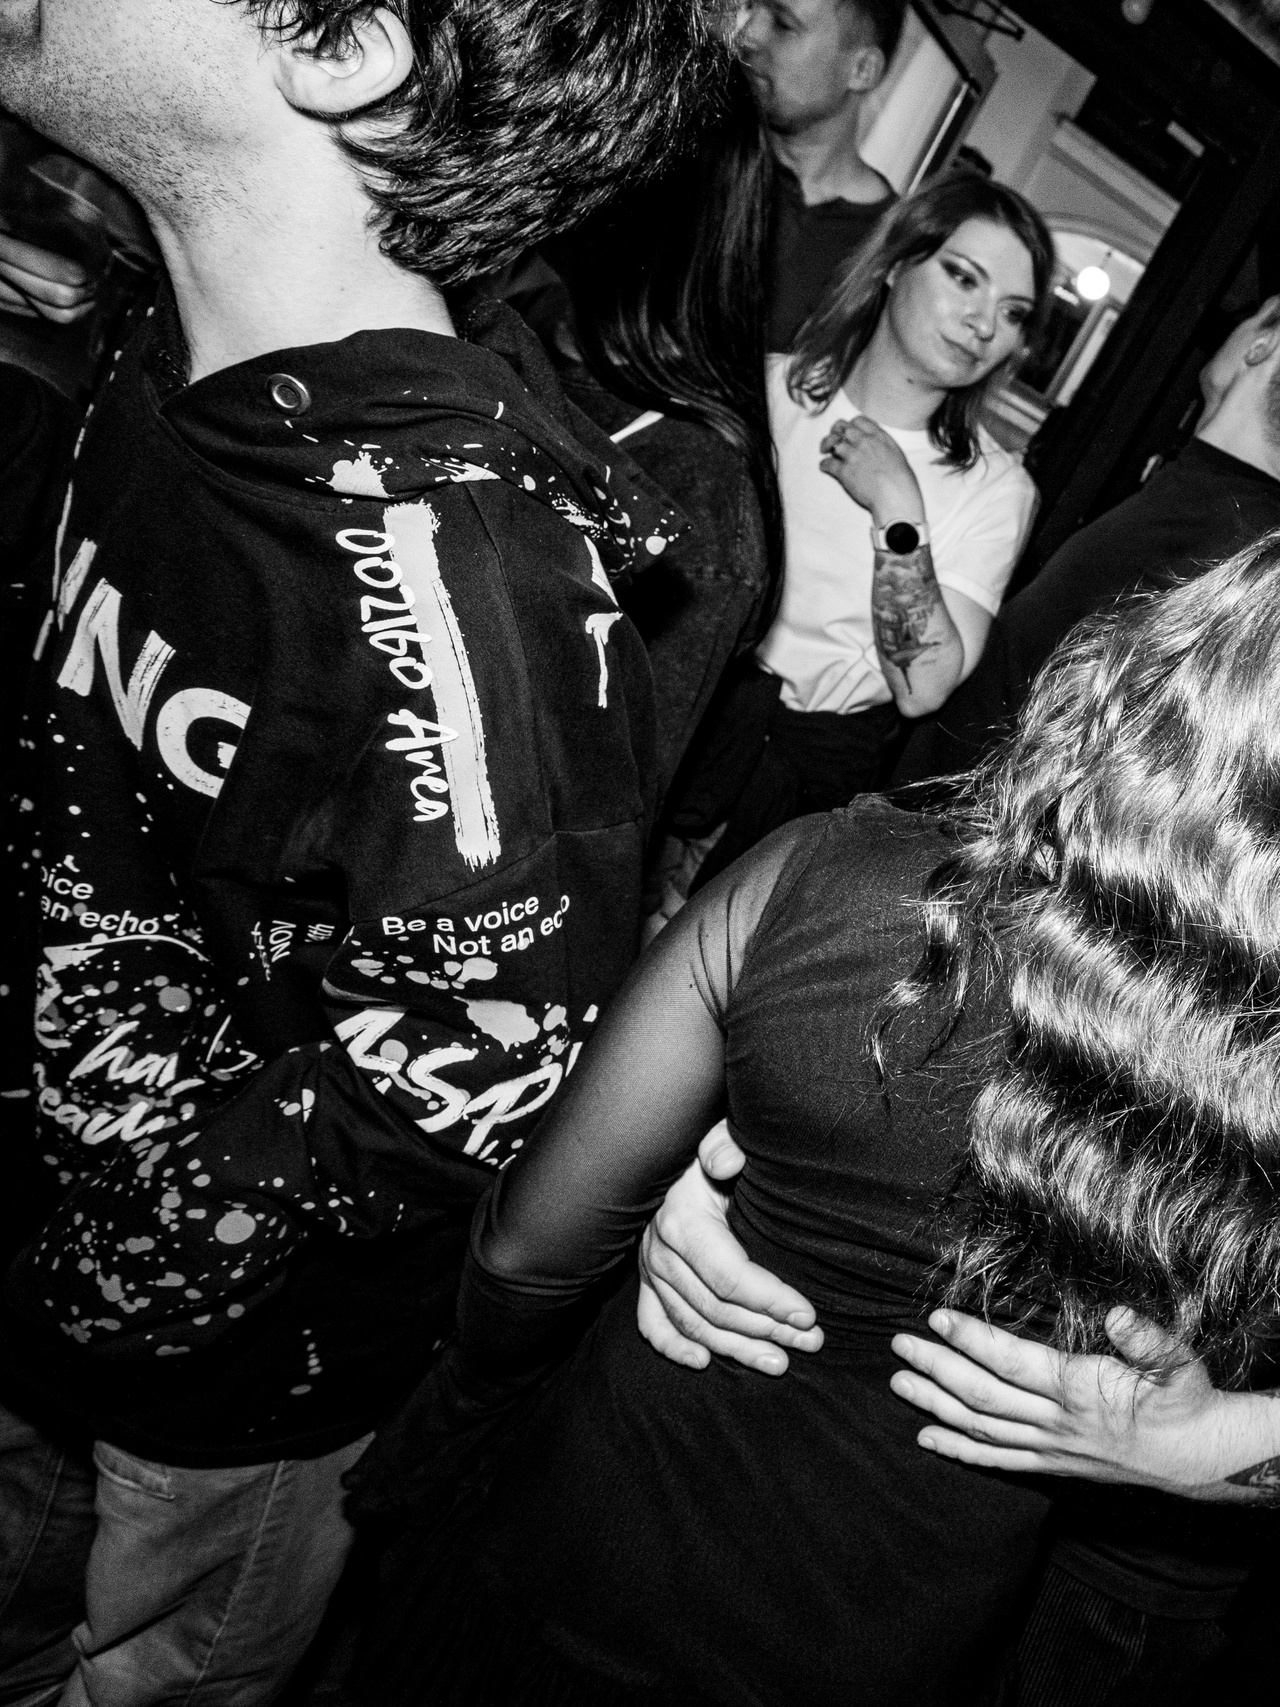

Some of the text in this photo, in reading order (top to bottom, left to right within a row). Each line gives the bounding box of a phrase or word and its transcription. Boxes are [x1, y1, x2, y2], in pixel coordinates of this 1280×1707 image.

[386, 709, 459, 821] Area
[79, 910, 159, 936] echo
[382, 896, 539, 936] Be a voice
[433, 934, 491, 955] Not
[500, 927, 534, 952] an
